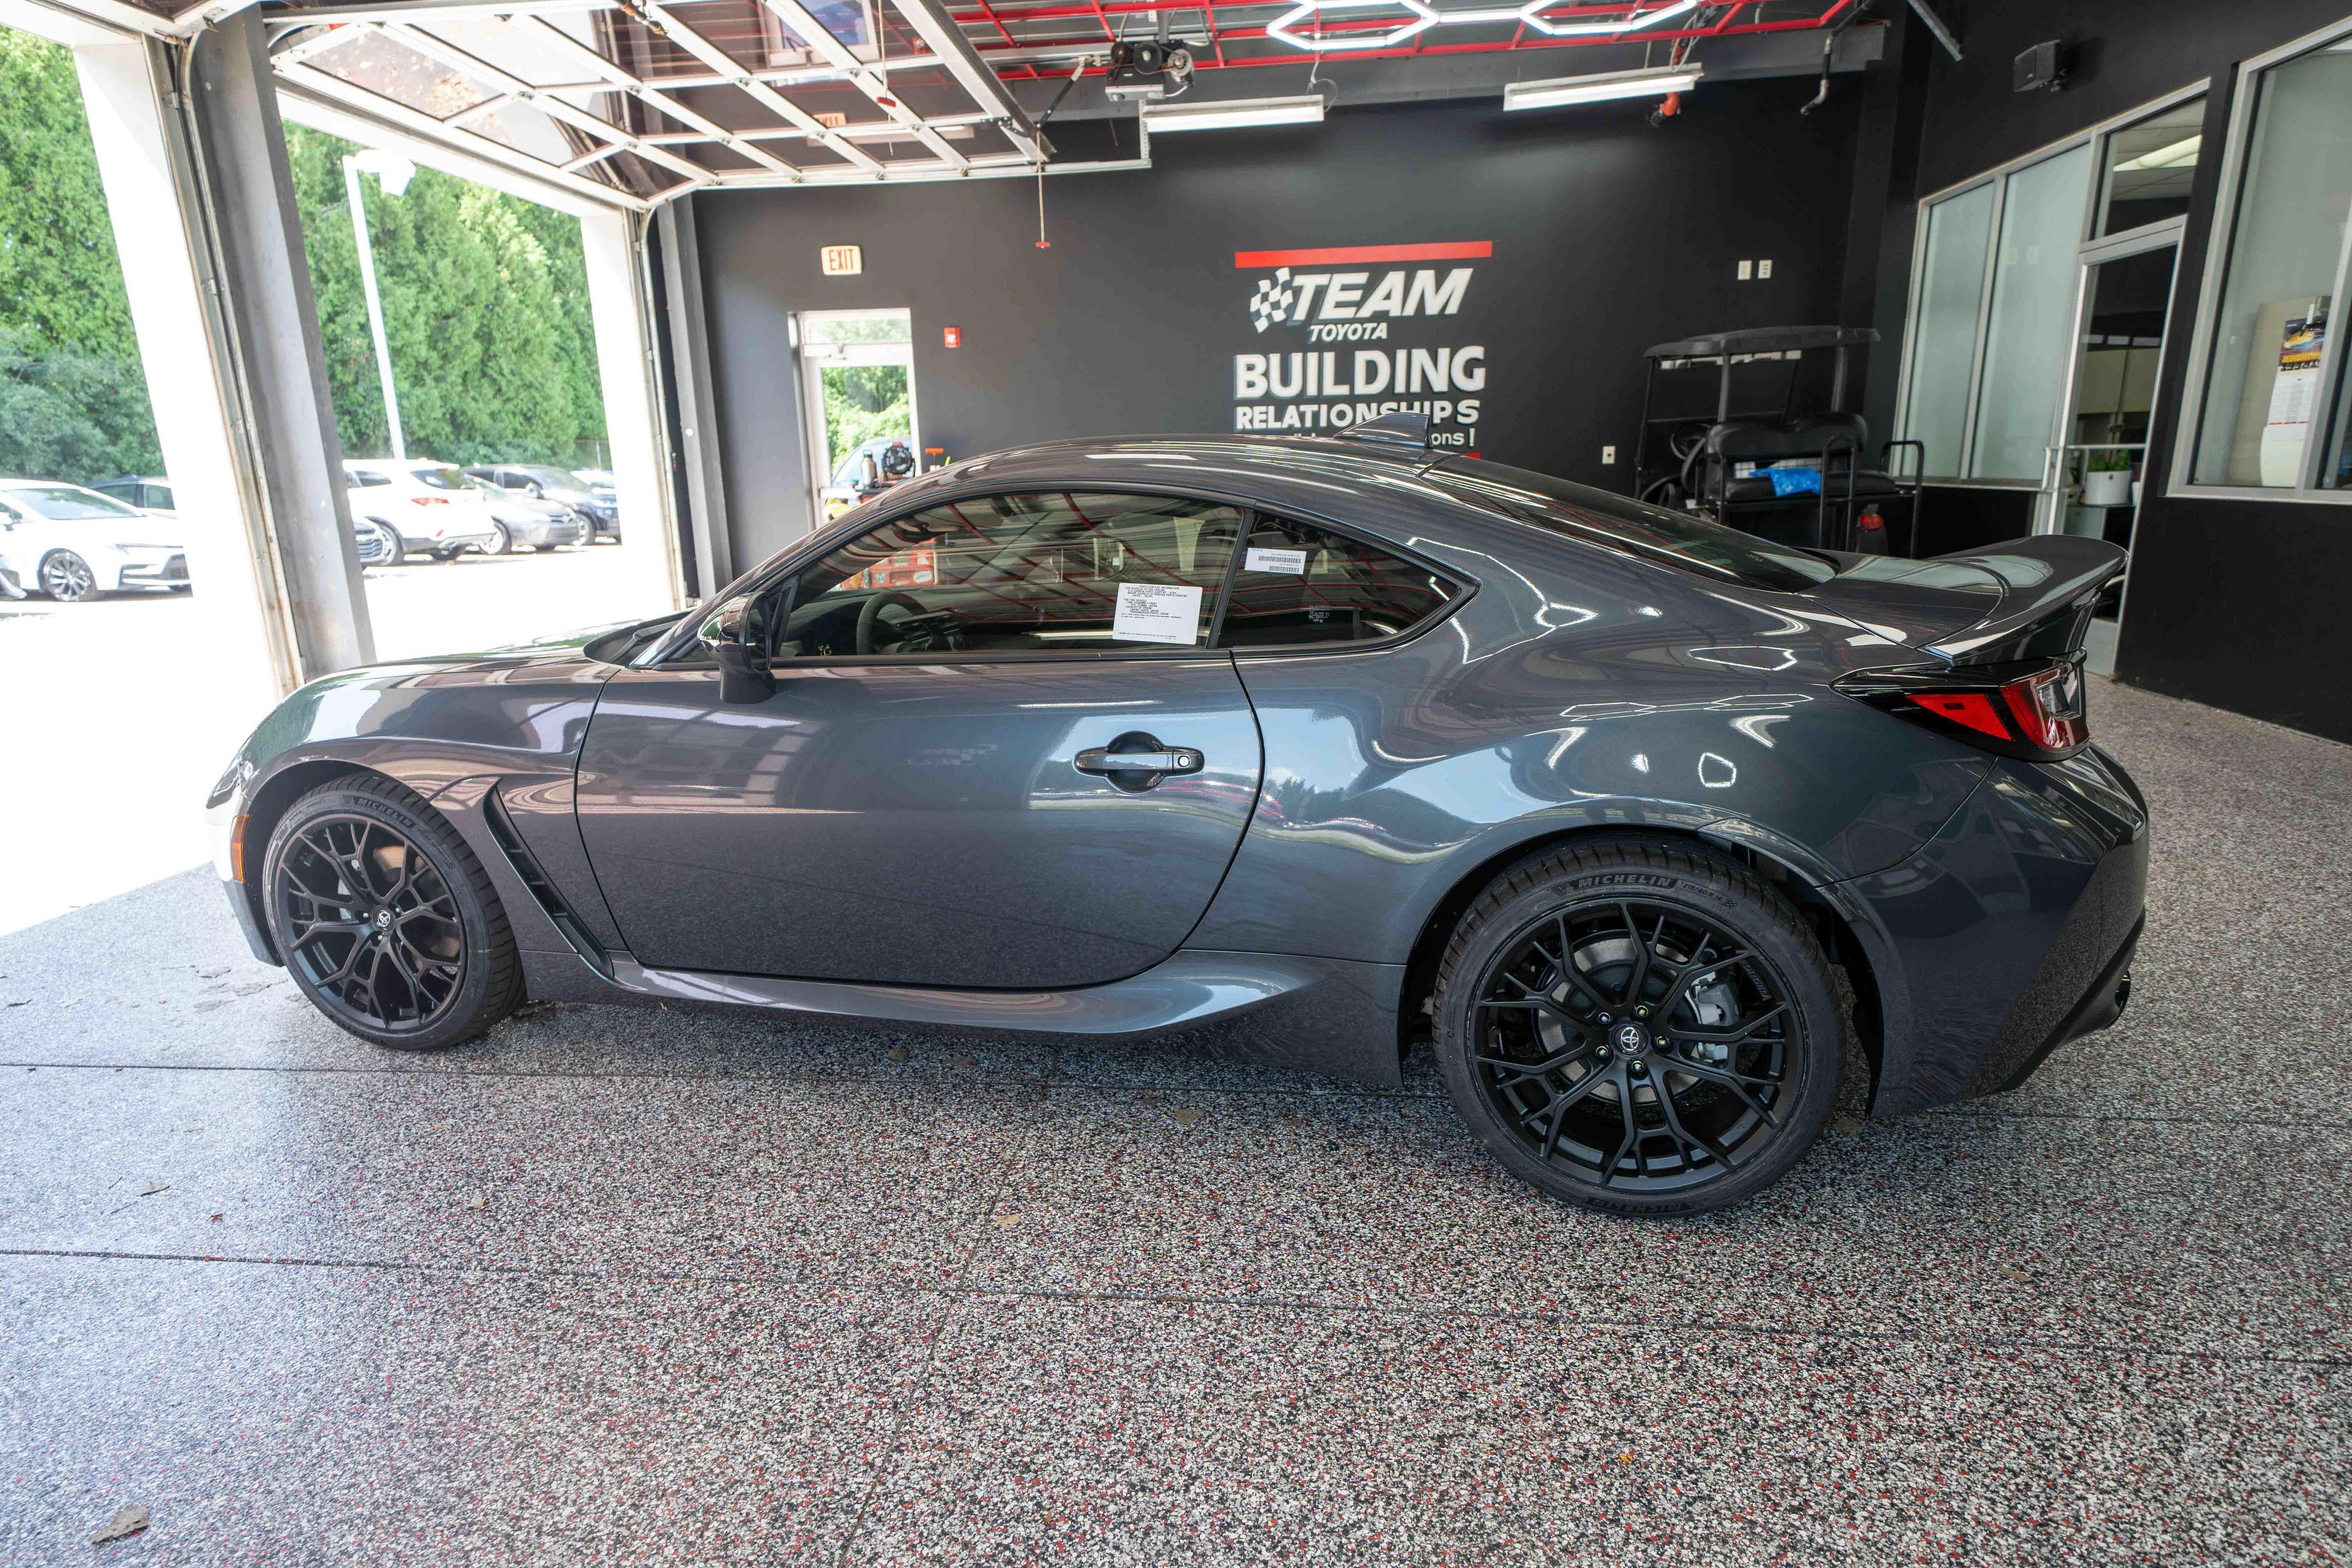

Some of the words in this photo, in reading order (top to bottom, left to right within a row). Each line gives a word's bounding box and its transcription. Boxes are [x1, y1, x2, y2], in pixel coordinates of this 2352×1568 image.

[829, 249, 853, 271] EXIT
[1292, 268, 1473, 321] TEAM
[1310, 323, 1388, 342] TOYOTA
[1236, 346, 1486, 398] BUILDING
[357, 796, 414, 828] MICHELIN
[1578, 875, 1672, 889] MICHELIN
